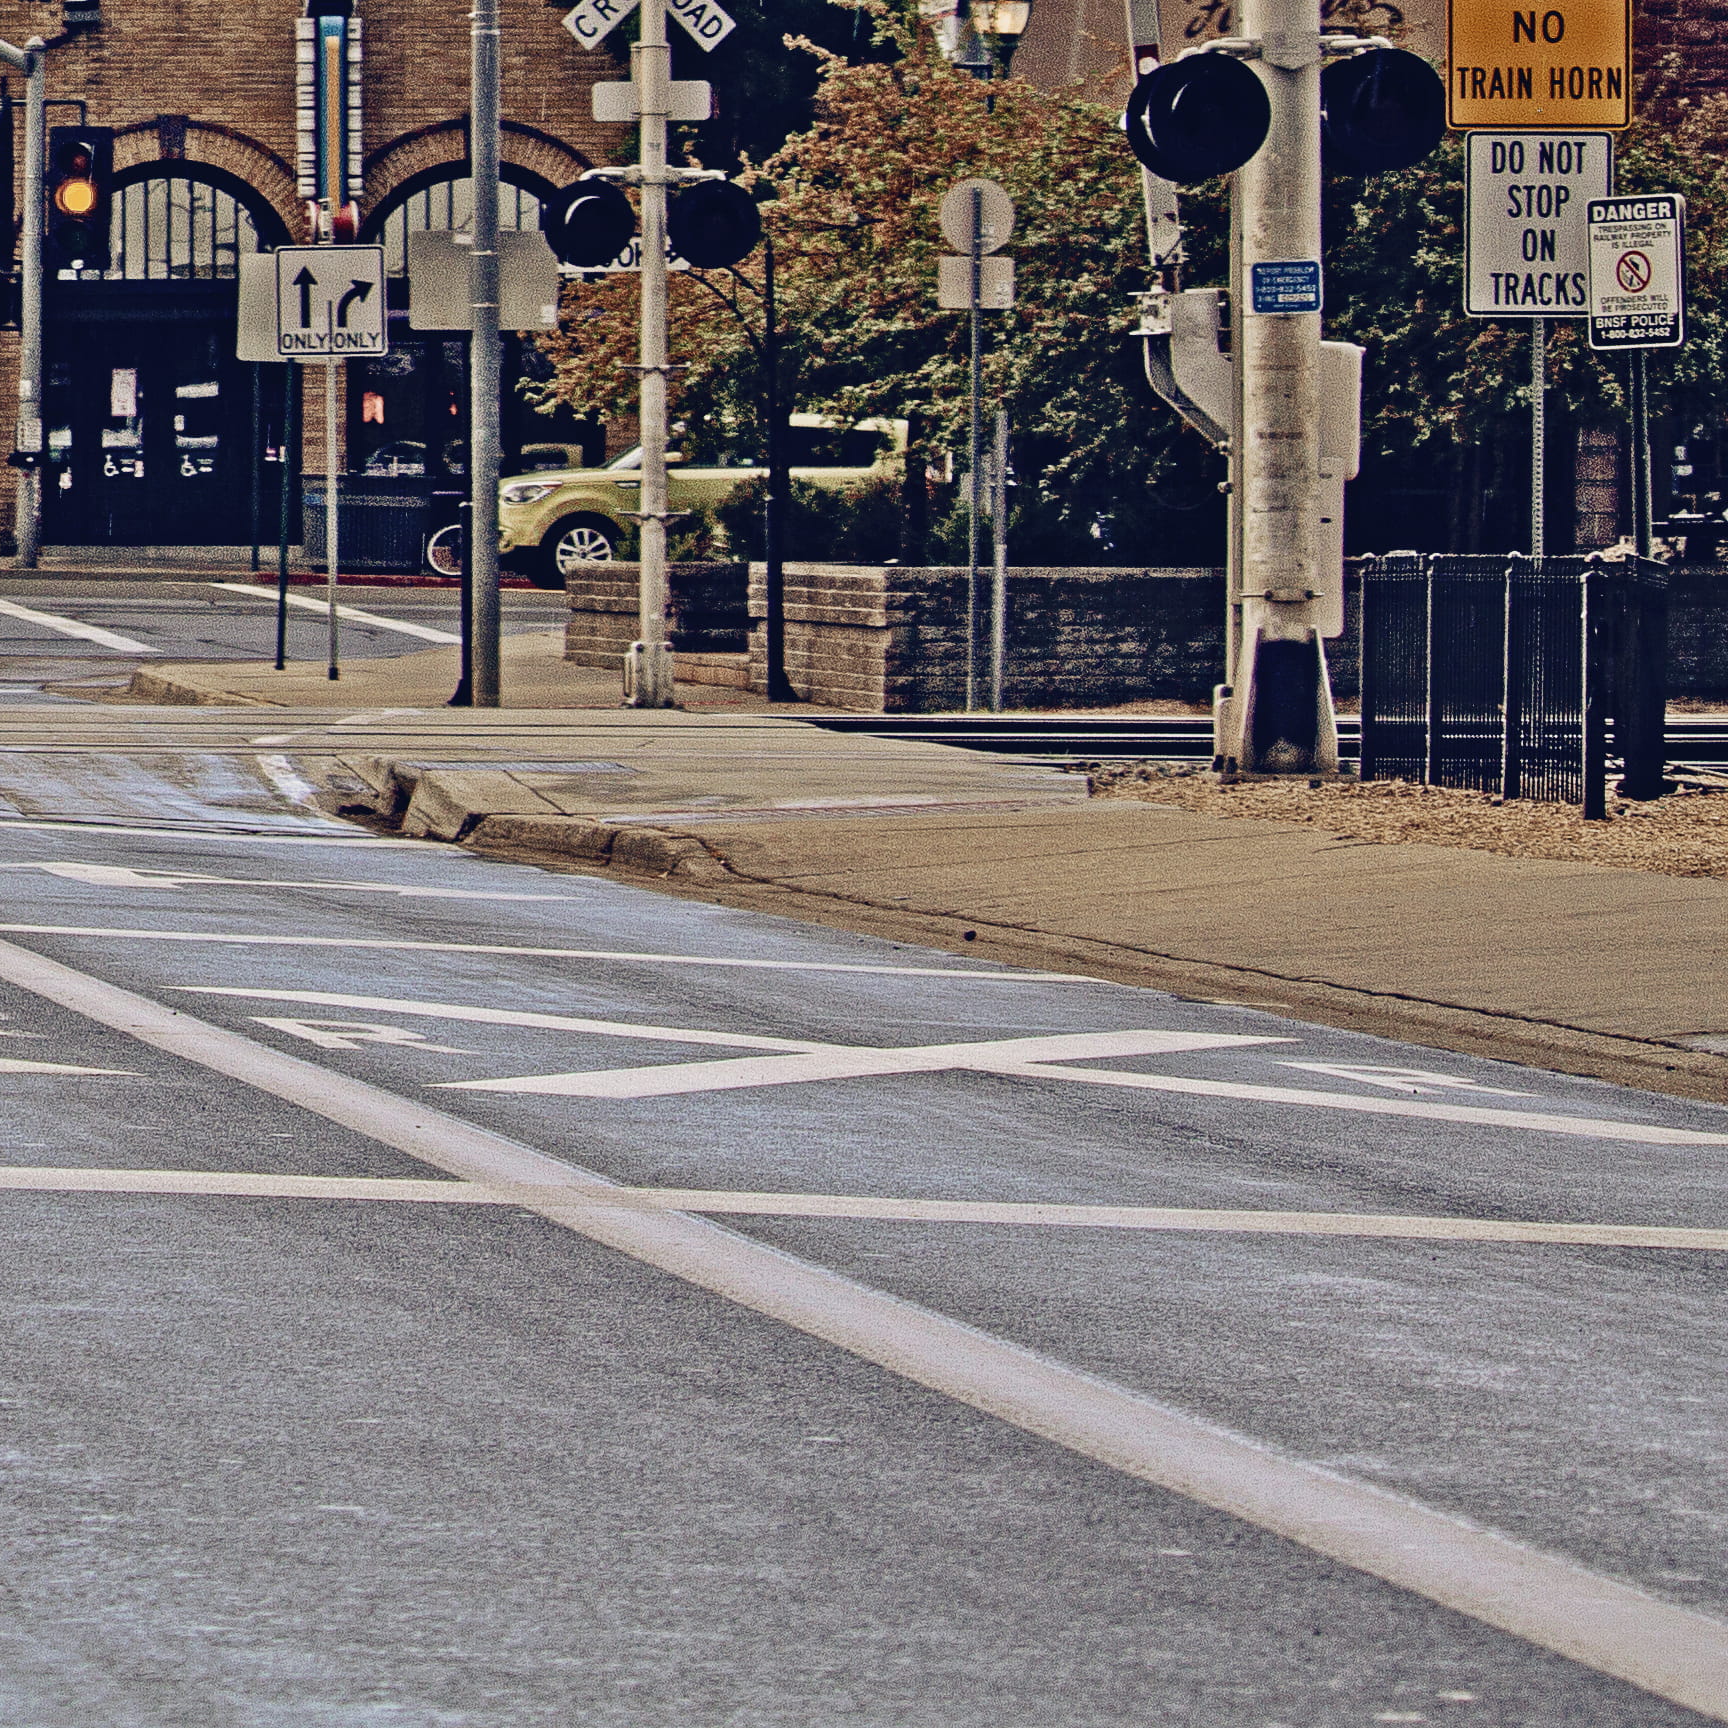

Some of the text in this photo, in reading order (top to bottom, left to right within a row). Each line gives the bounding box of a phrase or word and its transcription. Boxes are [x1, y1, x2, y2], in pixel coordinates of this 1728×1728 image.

[1513, 10, 1565, 43] NO
[1456, 66, 1622, 100] TRAIN HORN
[1491, 140, 1586, 174] DO NOT
[1507, 185, 1570, 218] STOP
[1592, 201, 1671, 222] DANGER
[1594, 230, 1672, 241] RAILWAY PROPERTY
[1598, 222, 1667, 234] TRESPASSING ON
[1522, 228, 1556, 262] ON
[1622, 239, 1654, 249] ILLEGAL
[1490, 272, 1586, 306] TRACKS
[1600, 293, 1668, 305] OFFENDERS WILL
[1615, 302, 1669, 311] PROSECUTED
[1596, 313, 1675, 328] BNSF POLICE
[283, 332, 380, 349] ONLY ONLY
